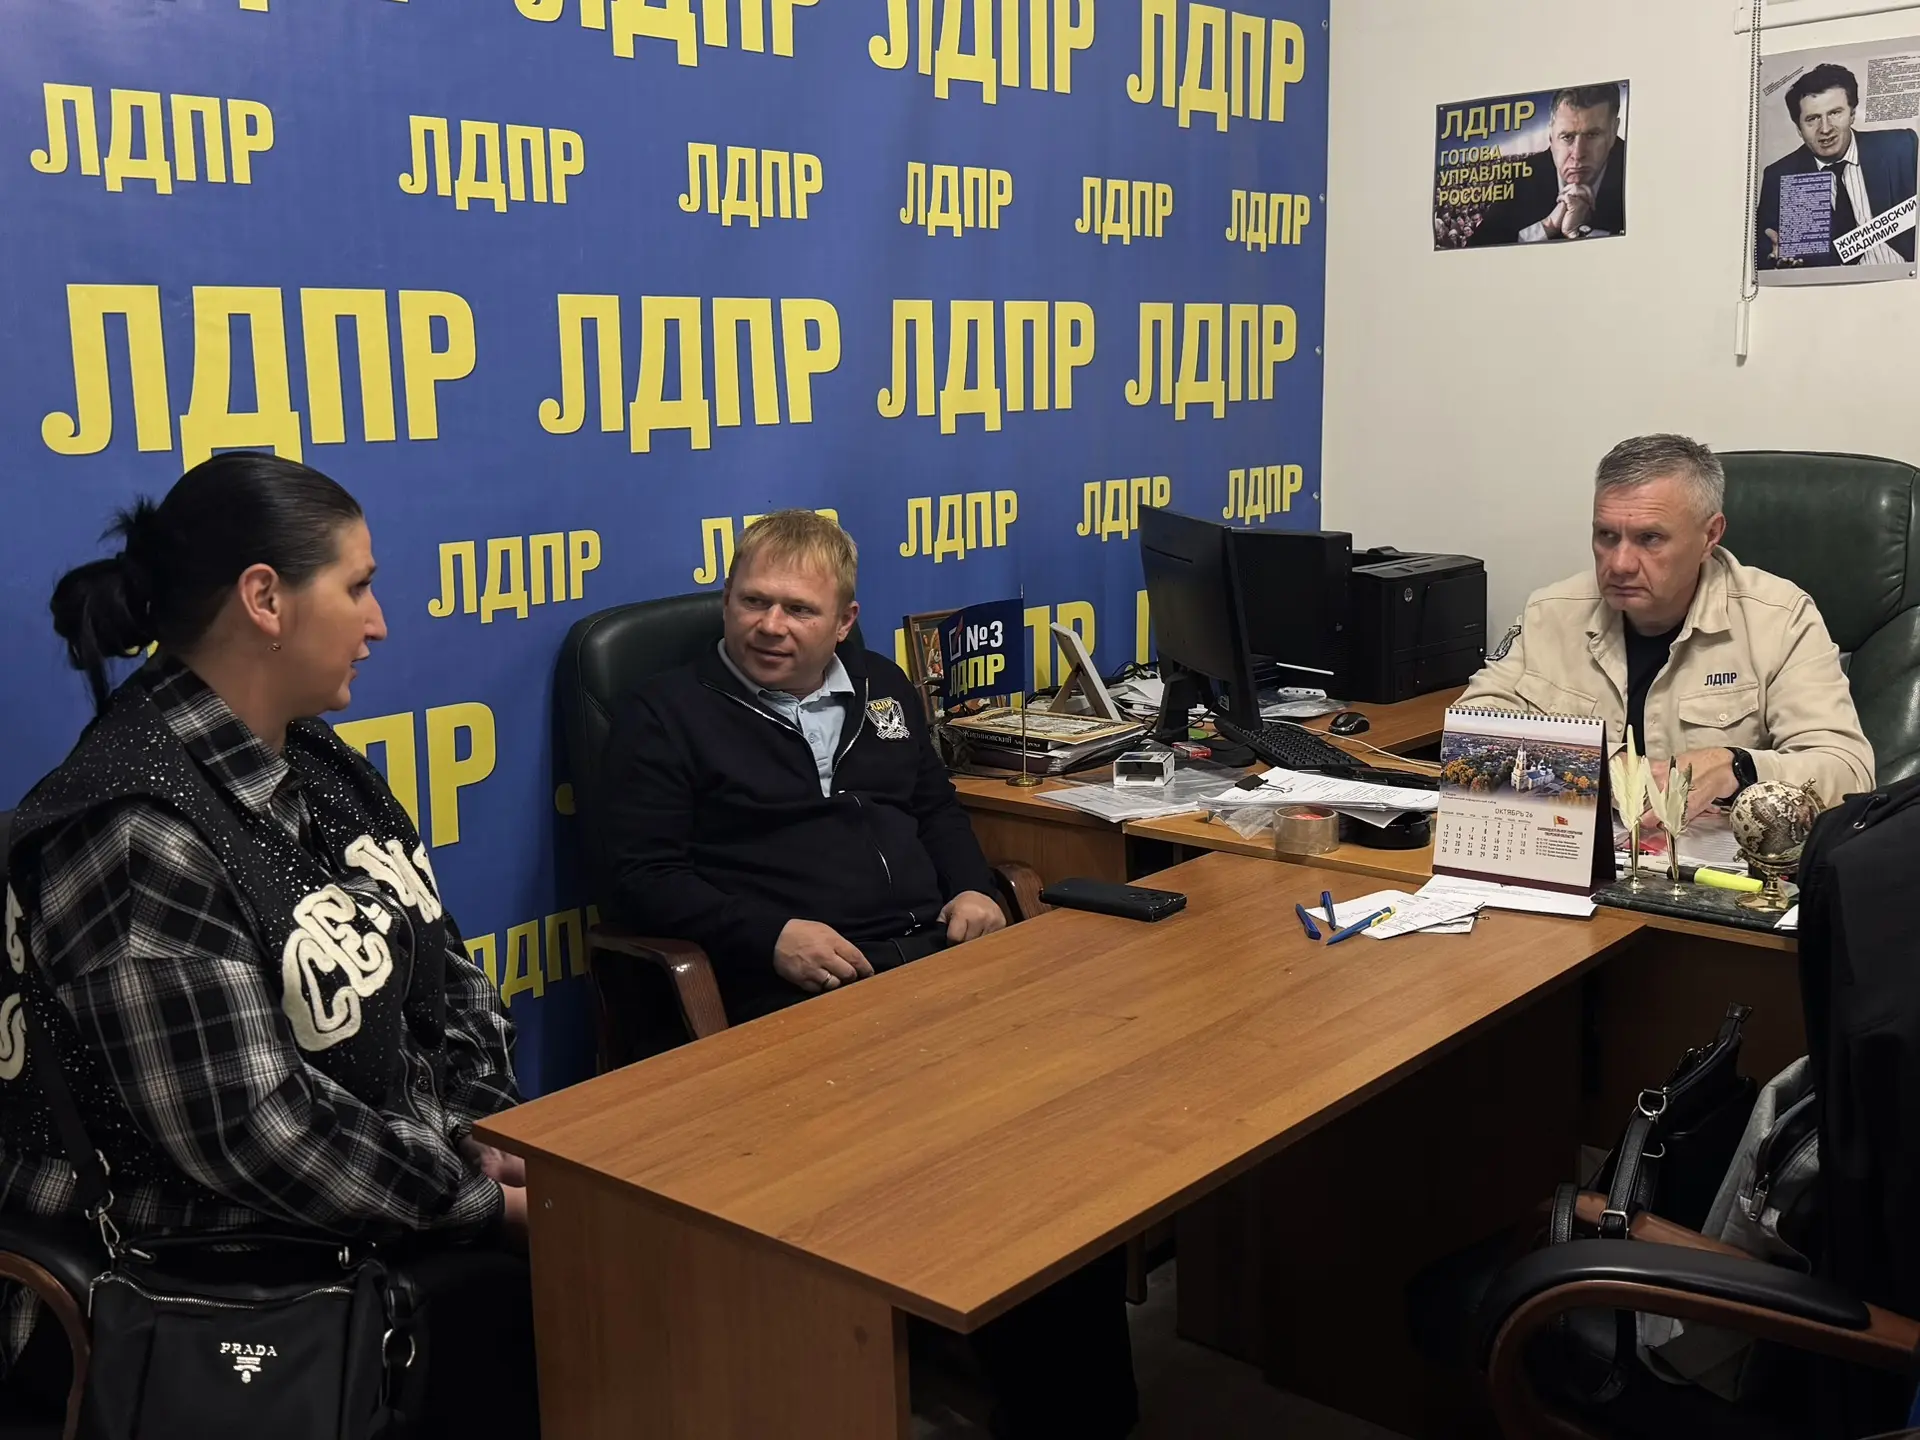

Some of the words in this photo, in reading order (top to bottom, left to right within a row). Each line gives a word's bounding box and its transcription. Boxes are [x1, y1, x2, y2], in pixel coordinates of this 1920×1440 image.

[1126, 0, 1306, 132] ЛДПР
[30, 82, 274, 195] ЛДПР
[1441, 101, 1535, 142] ЛДПР
[398, 114, 585, 213] ЛДПР
[678, 142, 823, 228] ЛДПР
[1440, 144, 1502, 167] ГОТОВА
[1440, 162, 1533, 187] УПРАВЛЯТЬ
[899, 161, 1013, 237] ЛДПР
[1075, 177, 1173, 245] ЛДПР
[1225, 189, 1311, 252] ЛДПР
[1439, 180, 1515, 206] РОССИЕЙ
[1836, 199, 1917, 251] ЖИРИНОВСКИЙ
[1841, 222, 1899, 260] ВЛАДИМИР
[41, 284, 477, 474] ЛДПР
[538, 293, 842, 454] ЛДПР
[876, 299, 1096, 436] ЛДПР
[1125, 302, 1298, 421] ЛДПР
[900, 490, 1019, 563] ЛДПР
[1222, 464, 1304, 526] ЛДПР
[428, 529, 602, 624] ЛДПР
[966, 620, 1004, 653] №3
[949, 653, 1006, 699] ЛДПР
[1703, 672, 1738, 687] ЛДПР
[219, 1341, 278, 1358] PRADA
